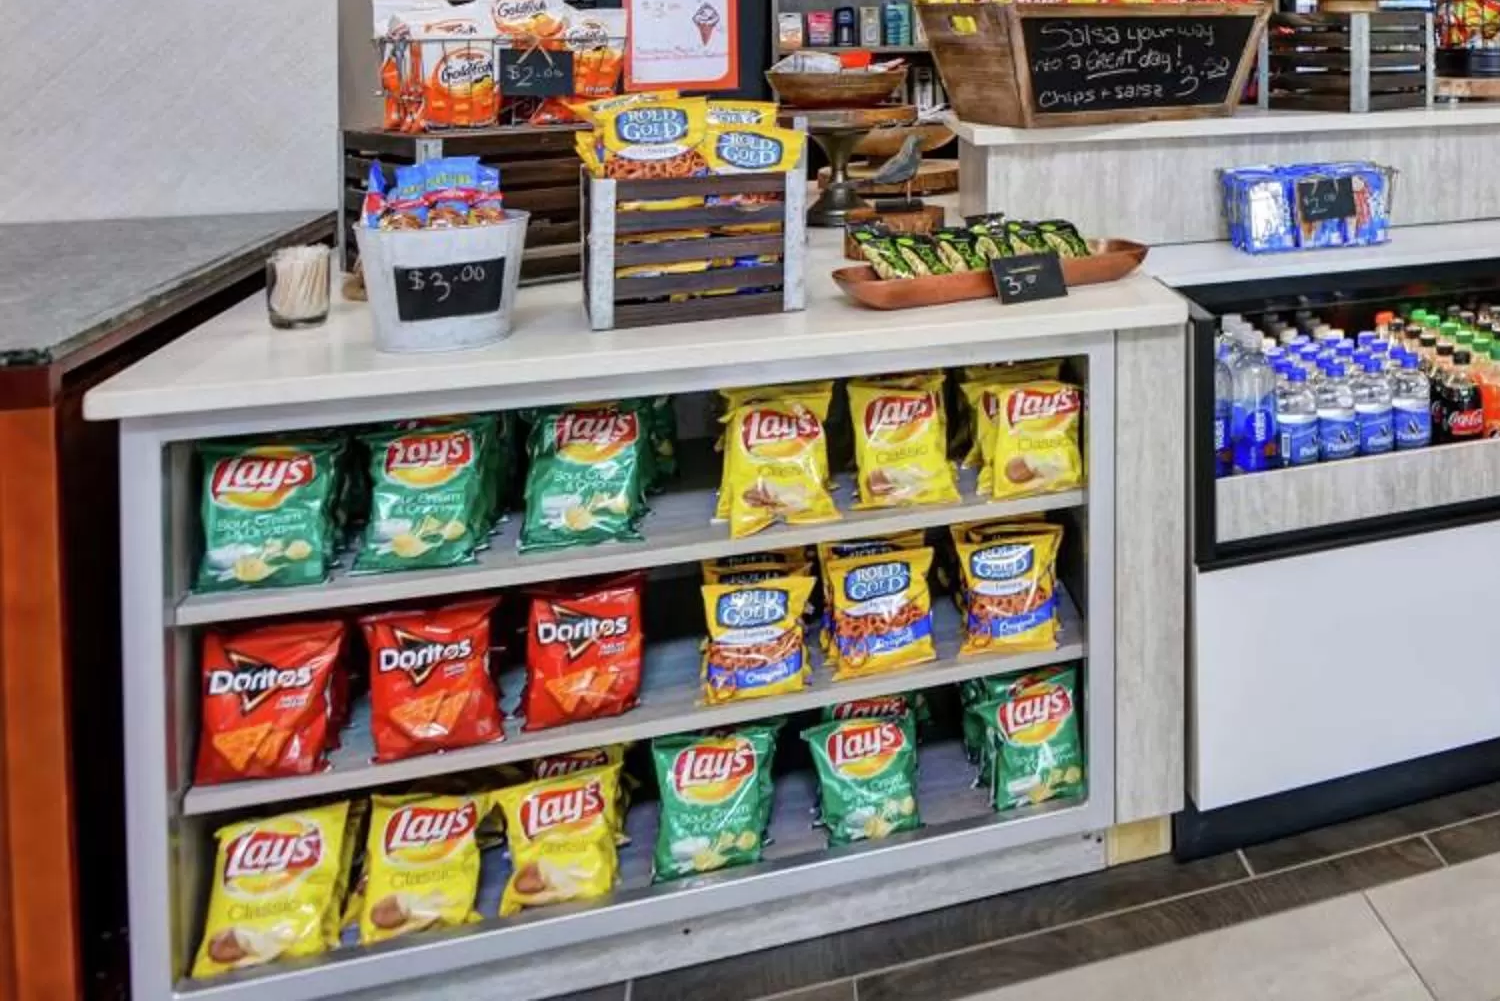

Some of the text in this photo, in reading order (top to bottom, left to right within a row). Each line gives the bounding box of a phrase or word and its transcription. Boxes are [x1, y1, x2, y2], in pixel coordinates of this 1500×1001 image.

[1040, 21, 1121, 49] Salsa
[1127, 26, 1174, 50] your
[1039, 89, 1096, 108] Chips
[622, 121, 682, 139] GOLD
[407, 265, 486, 302] $3.00
[538, 616, 629, 644] Doritos
[379, 638, 471, 673] Doritos
[209, 666, 312, 695] Doritos
